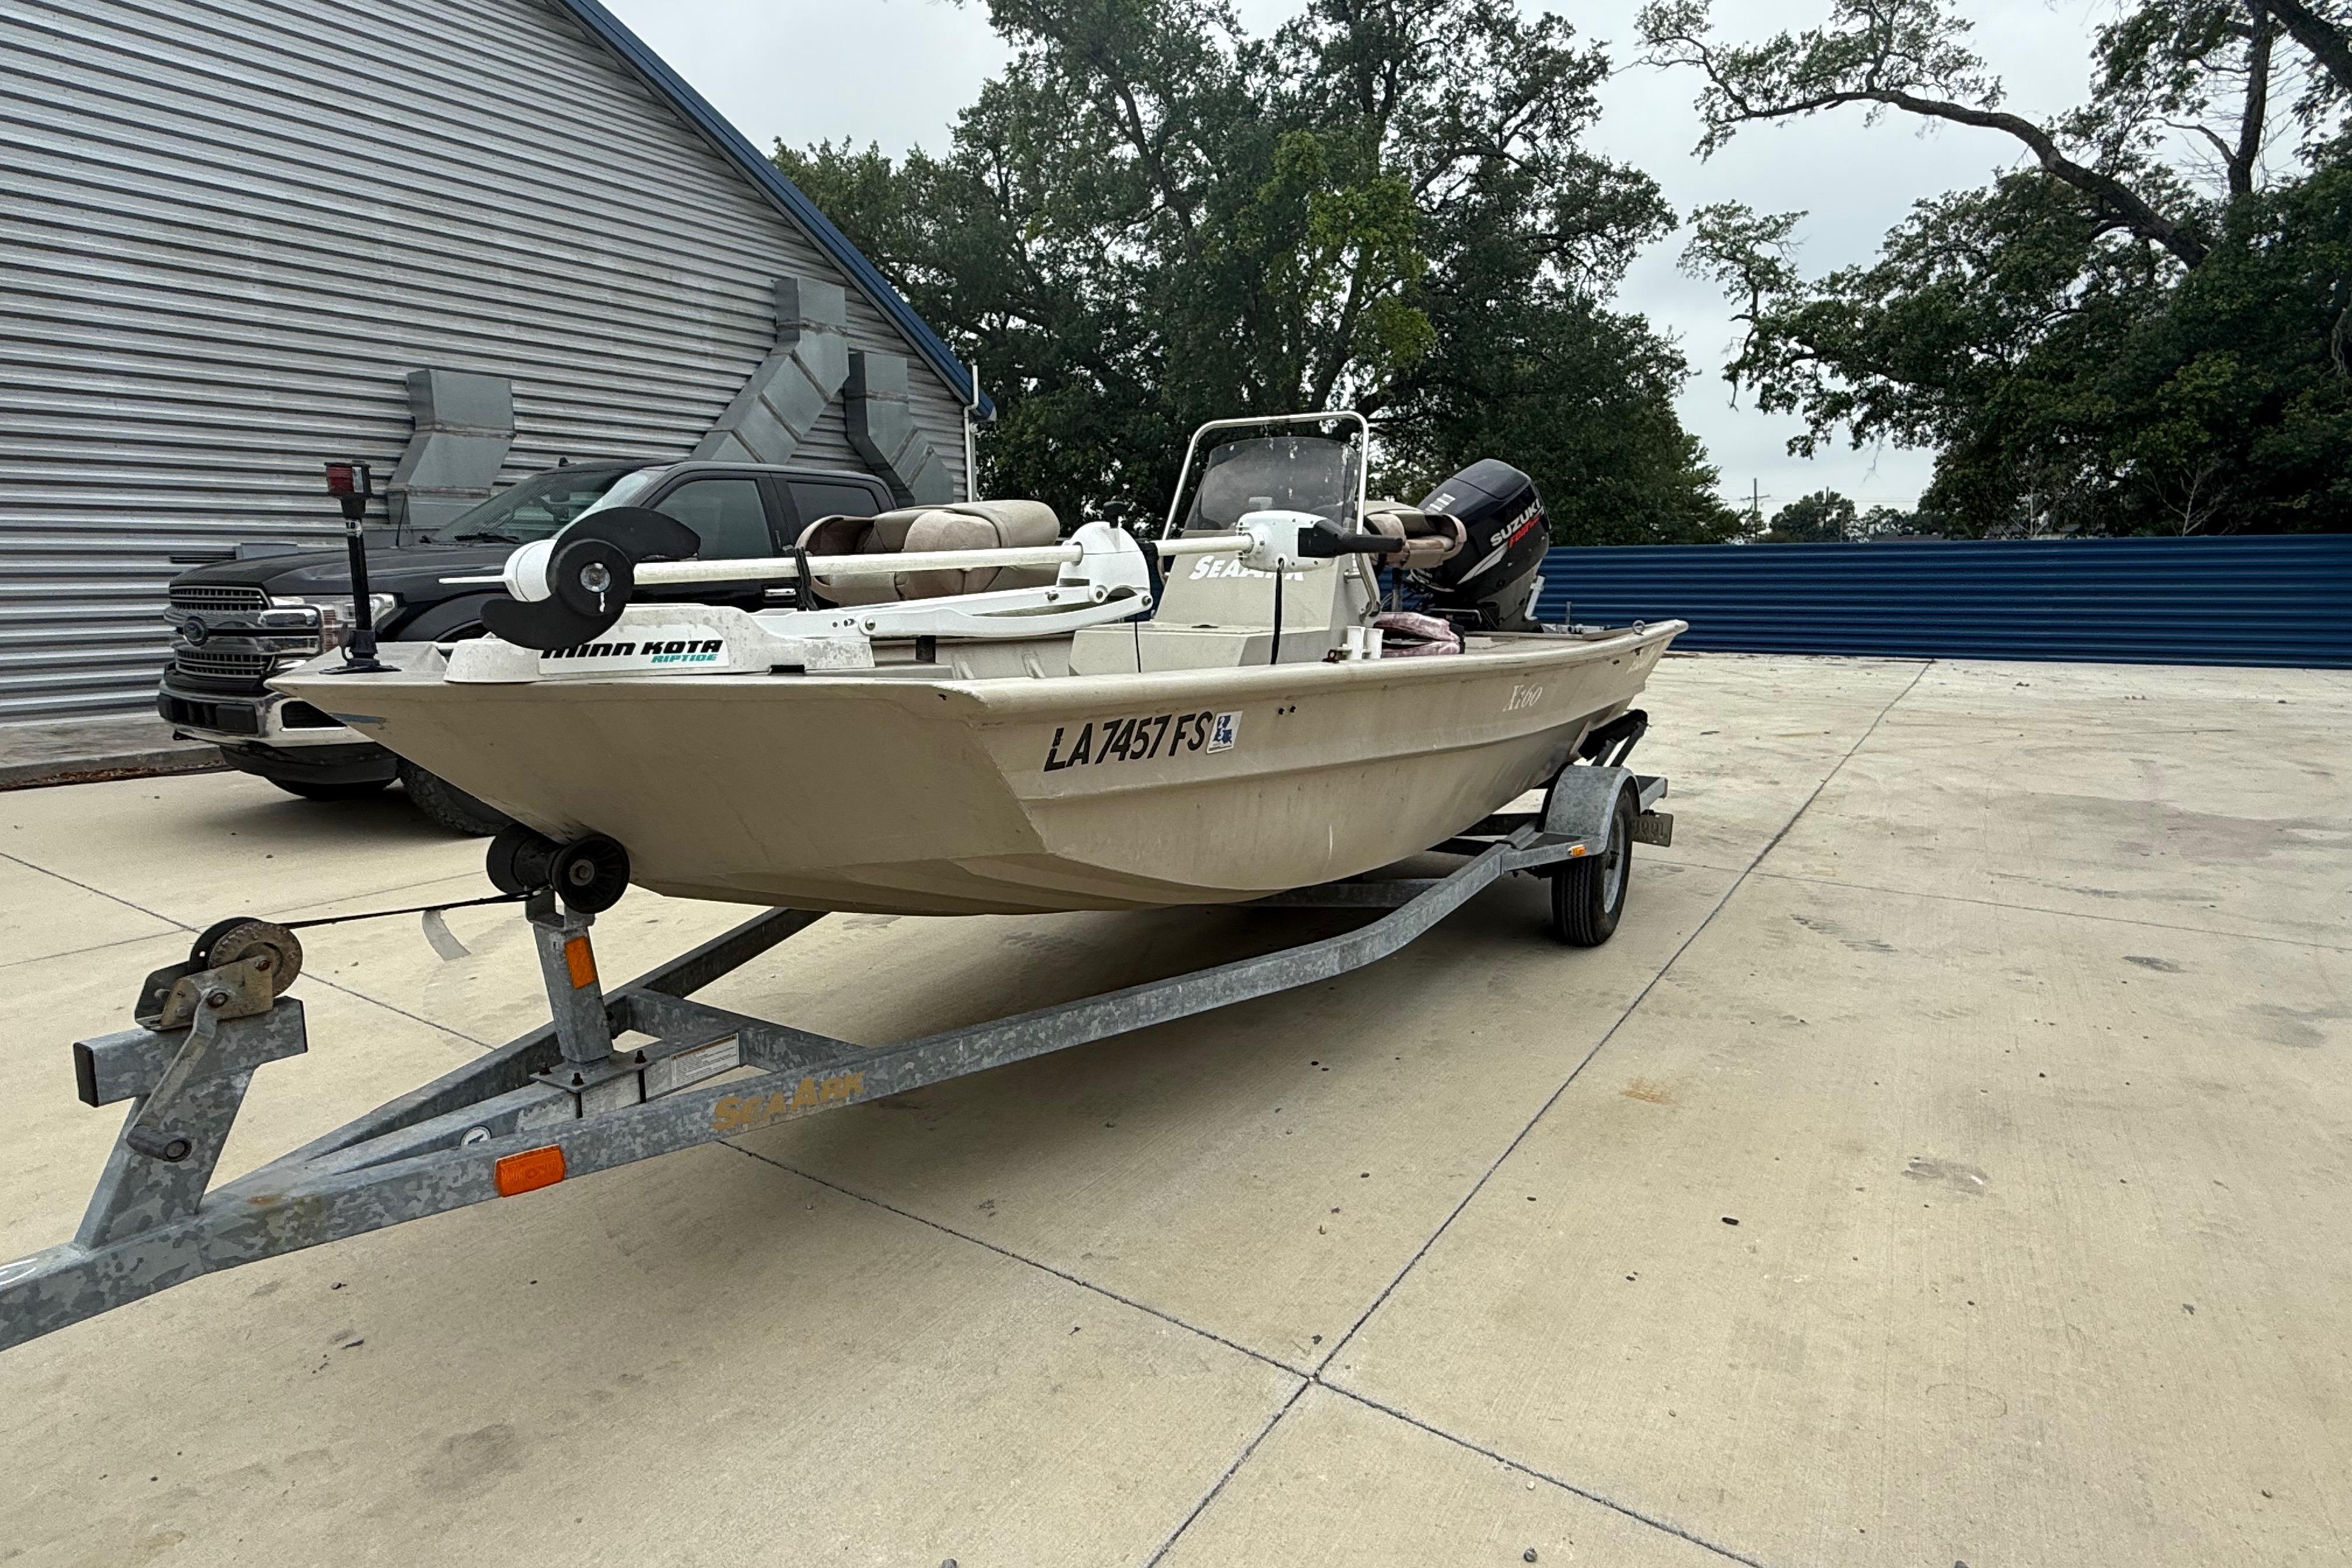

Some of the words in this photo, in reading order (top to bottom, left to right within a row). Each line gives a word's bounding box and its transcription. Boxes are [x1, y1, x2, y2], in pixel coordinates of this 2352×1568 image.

[1490, 498, 1541, 547] SUZUKI
[640, 640, 723, 655] KOTA
[650, 654, 718, 663] RIPTIDE
[1044, 722, 1093, 772] LA
[1095, 714, 1172, 764] 7457
[1168, 711, 1213, 757] FS
